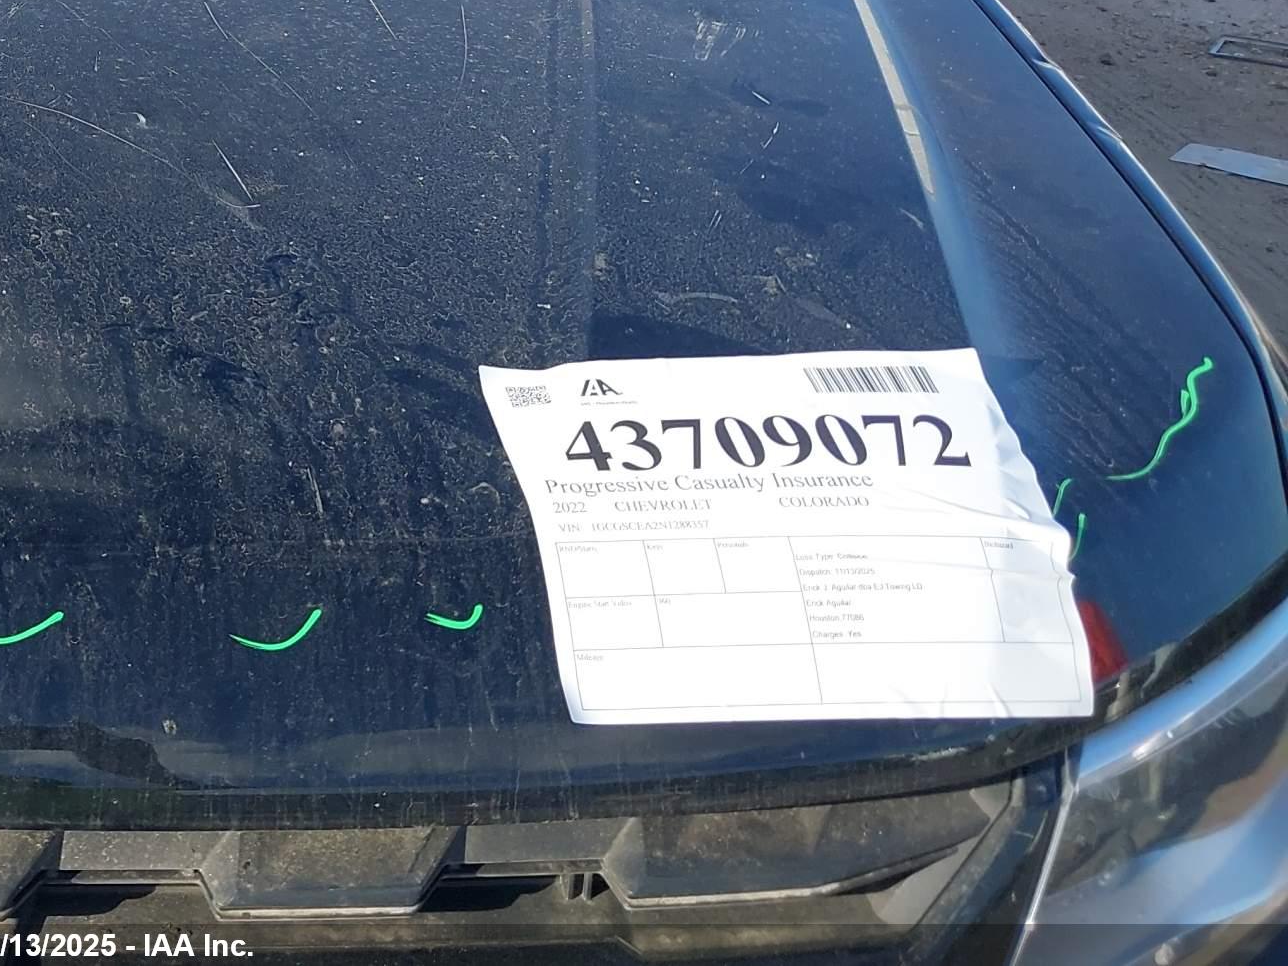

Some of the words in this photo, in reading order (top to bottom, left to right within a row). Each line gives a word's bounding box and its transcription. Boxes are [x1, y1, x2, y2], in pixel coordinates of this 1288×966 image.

[565, 412, 972, 472] 43709072
[544, 475, 670, 498] Progressive
[673, 472, 765, 494] Casualty
[772, 472, 874, 489] Insurance
[553, 501, 588, 514] 2022
[613, 498, 712, 513] CHEVROLET
[778, 496, 871, 508] COLORADO
